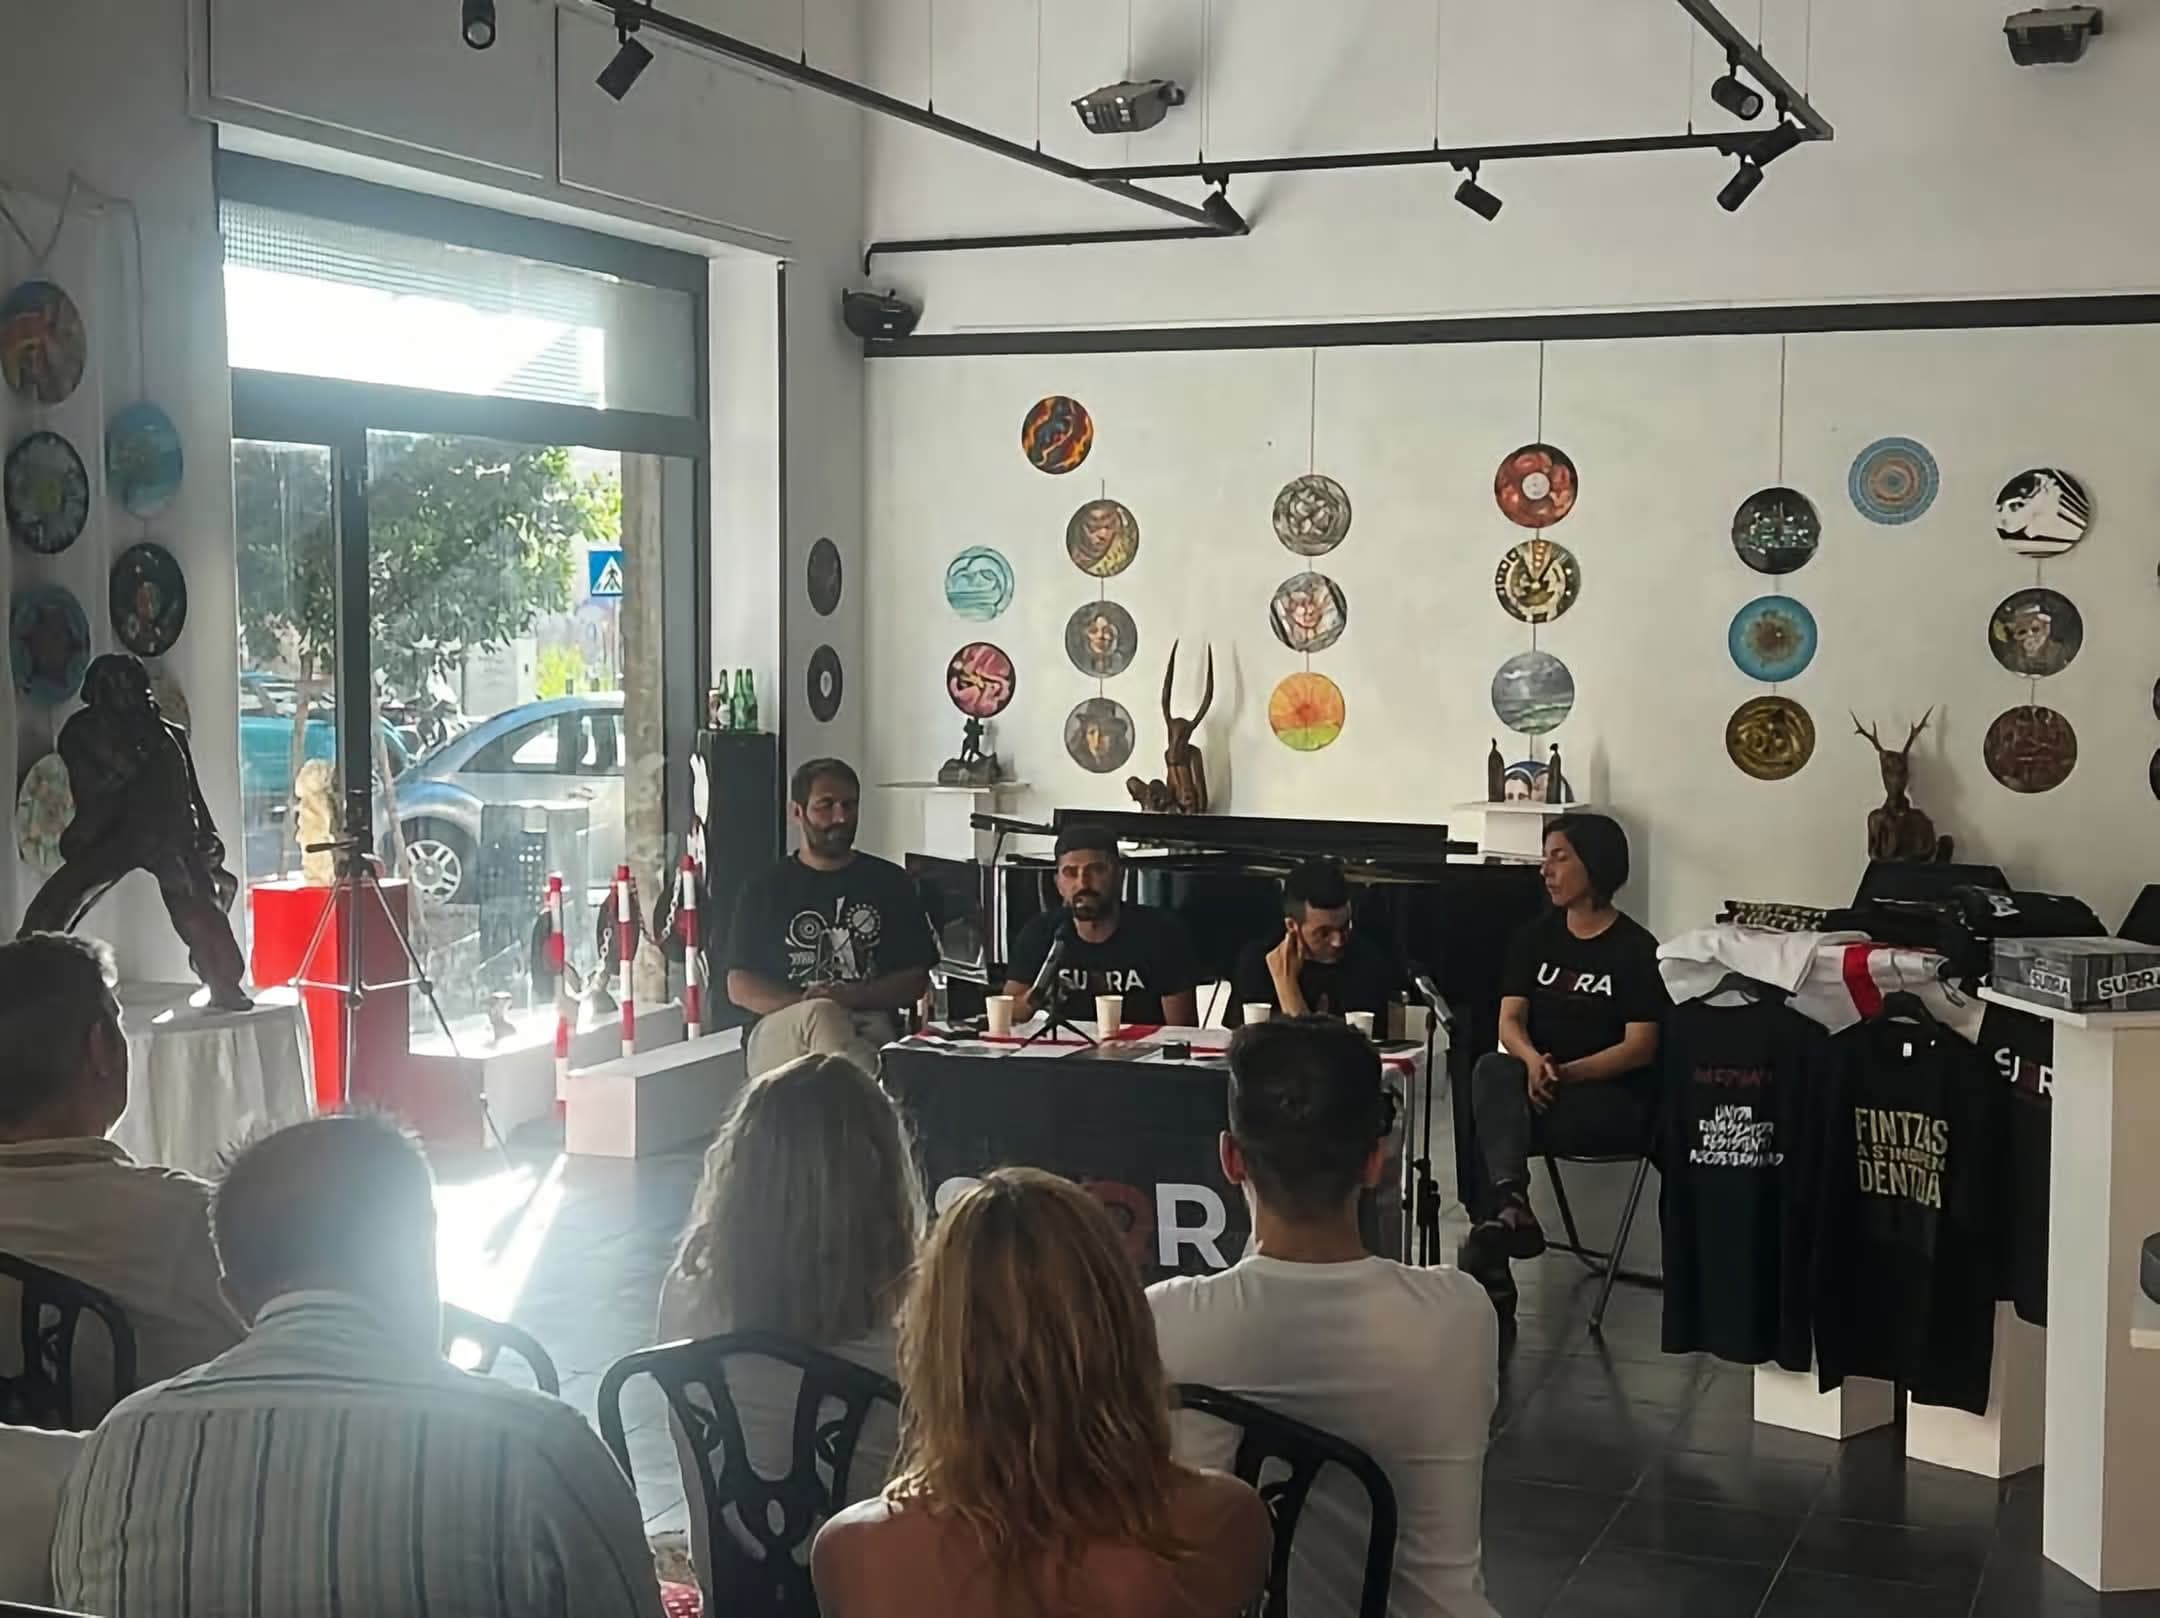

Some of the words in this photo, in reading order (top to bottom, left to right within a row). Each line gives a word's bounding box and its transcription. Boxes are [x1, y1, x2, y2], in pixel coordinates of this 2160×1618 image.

[1058, 968, 1145, 992] SURA
[1537, 962, 1612, 997] URA
[1855, 1107, 1948, 1155] FINTZAS
